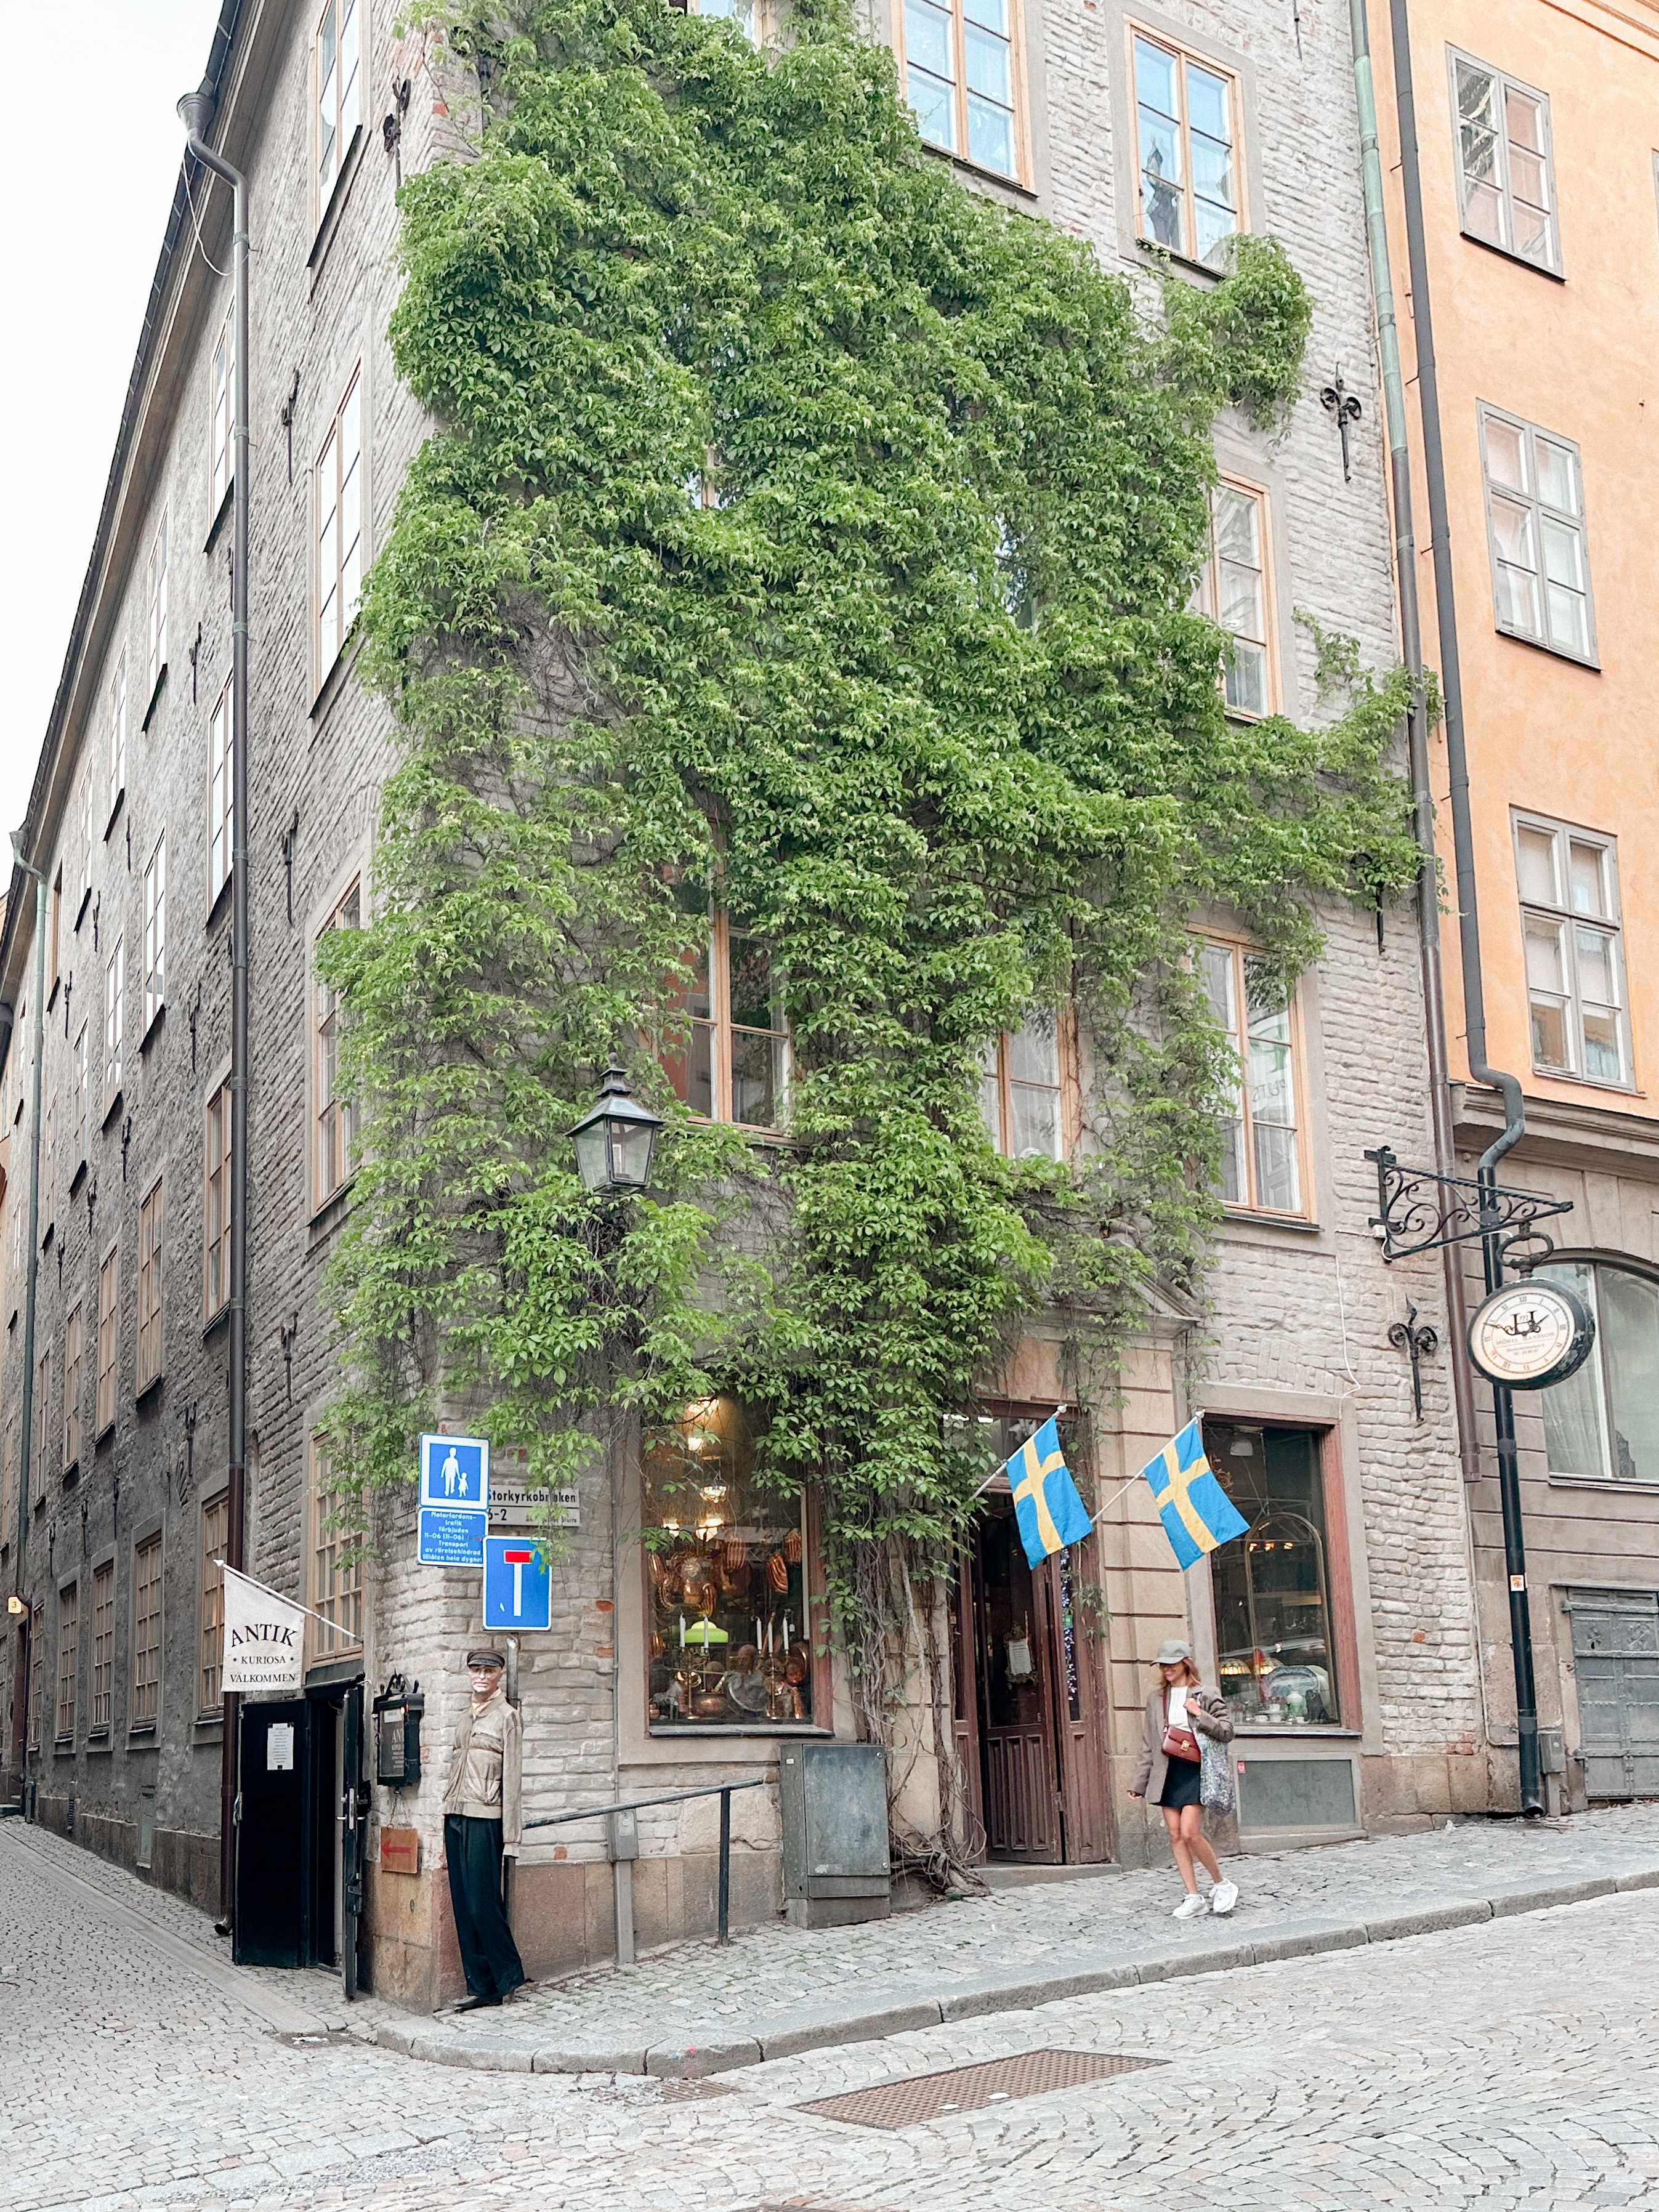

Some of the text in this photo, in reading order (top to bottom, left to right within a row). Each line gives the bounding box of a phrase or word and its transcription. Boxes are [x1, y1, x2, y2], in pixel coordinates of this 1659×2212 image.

[232, 1623, 297, 1647] ANTIK
[241, 1655, 286, 1664] KURIOSA
[230, 1672, 296, 1682] VÄLKOMMEN
